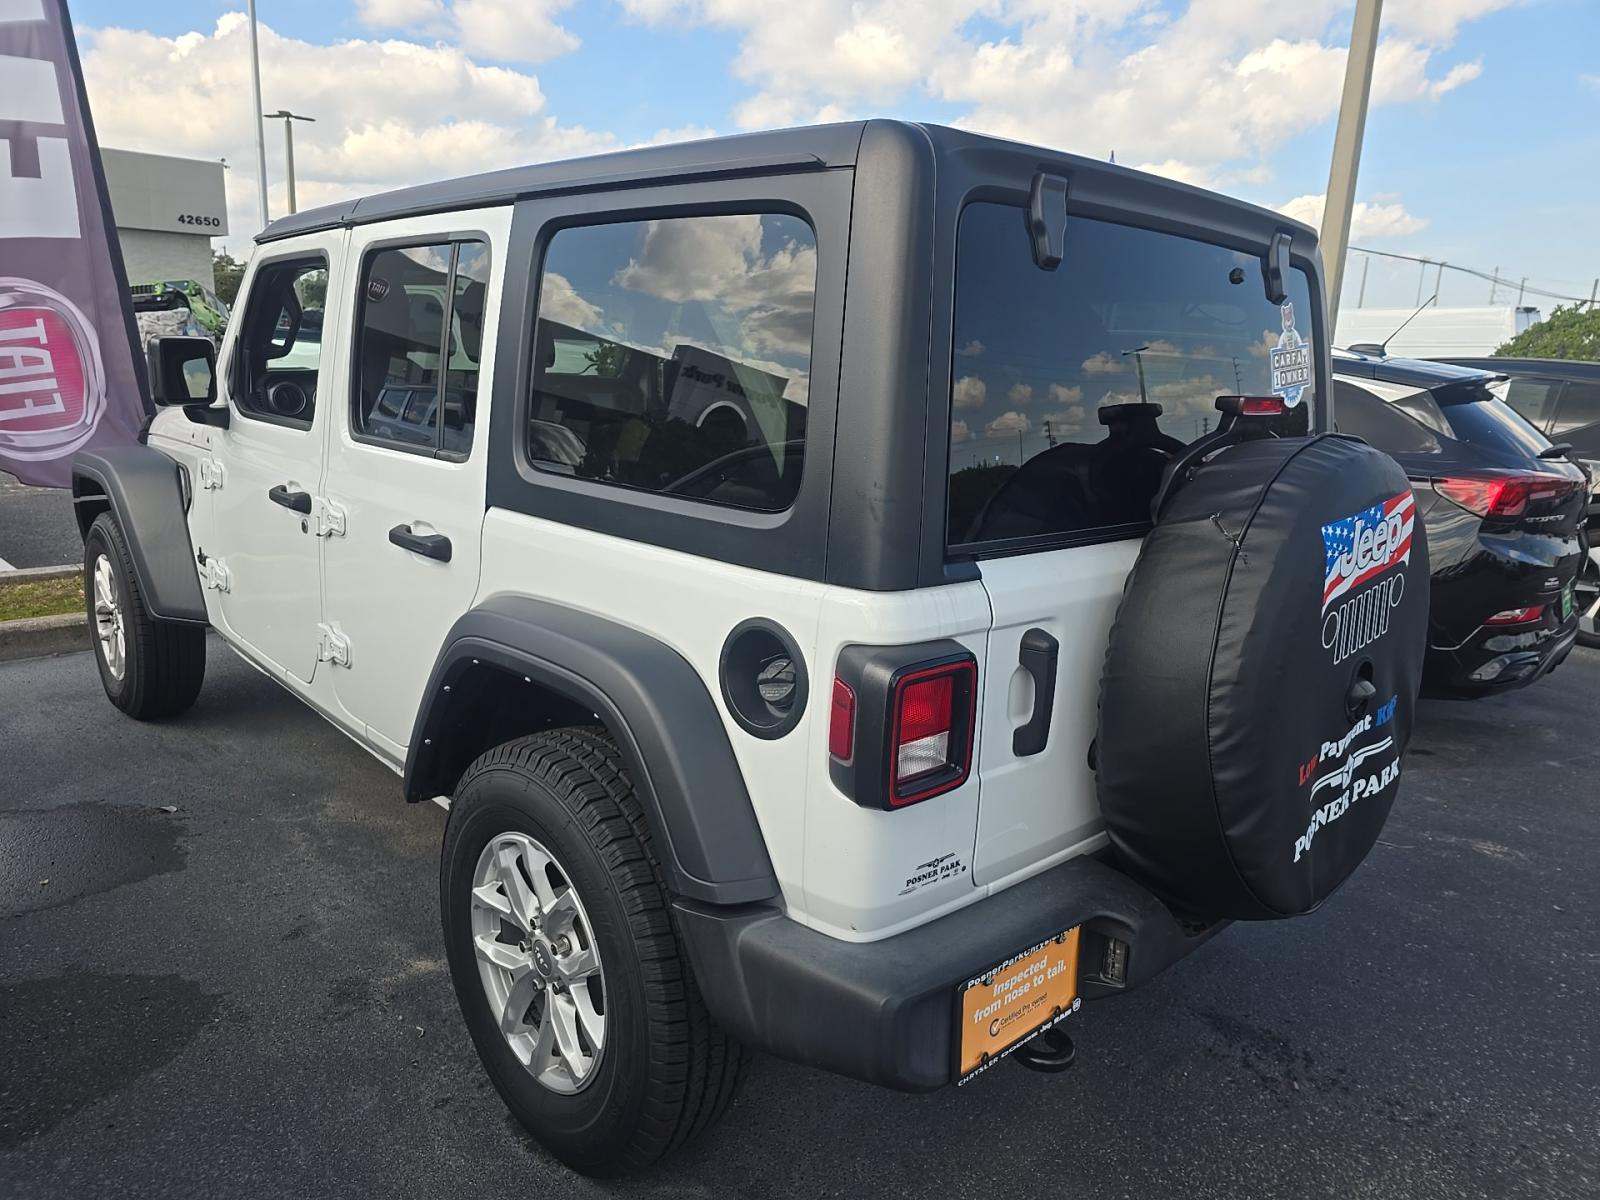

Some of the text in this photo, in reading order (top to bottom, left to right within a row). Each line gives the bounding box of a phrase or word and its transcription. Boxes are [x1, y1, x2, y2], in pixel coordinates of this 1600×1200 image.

[178, 214, 220, 227] 42650
[1281, 369, 1308, 385] OWNER
[1340, 512, 1403, 578] Jeep
[1351, 756, 1400, 803] PARK
[905, 868, 938, 887] POSNER
[939, 860, 961, 874] PARK
[974, 999, 1001, 1024] from
[1004, 982, 1031, 1005] nose
[1033, 974, 1044, 987] to
[1047, 959, 1066, 980] tail.
[993, 955, 1048, 997] Inspected
[958, 1057, 999, 1087] CHRYSLER
